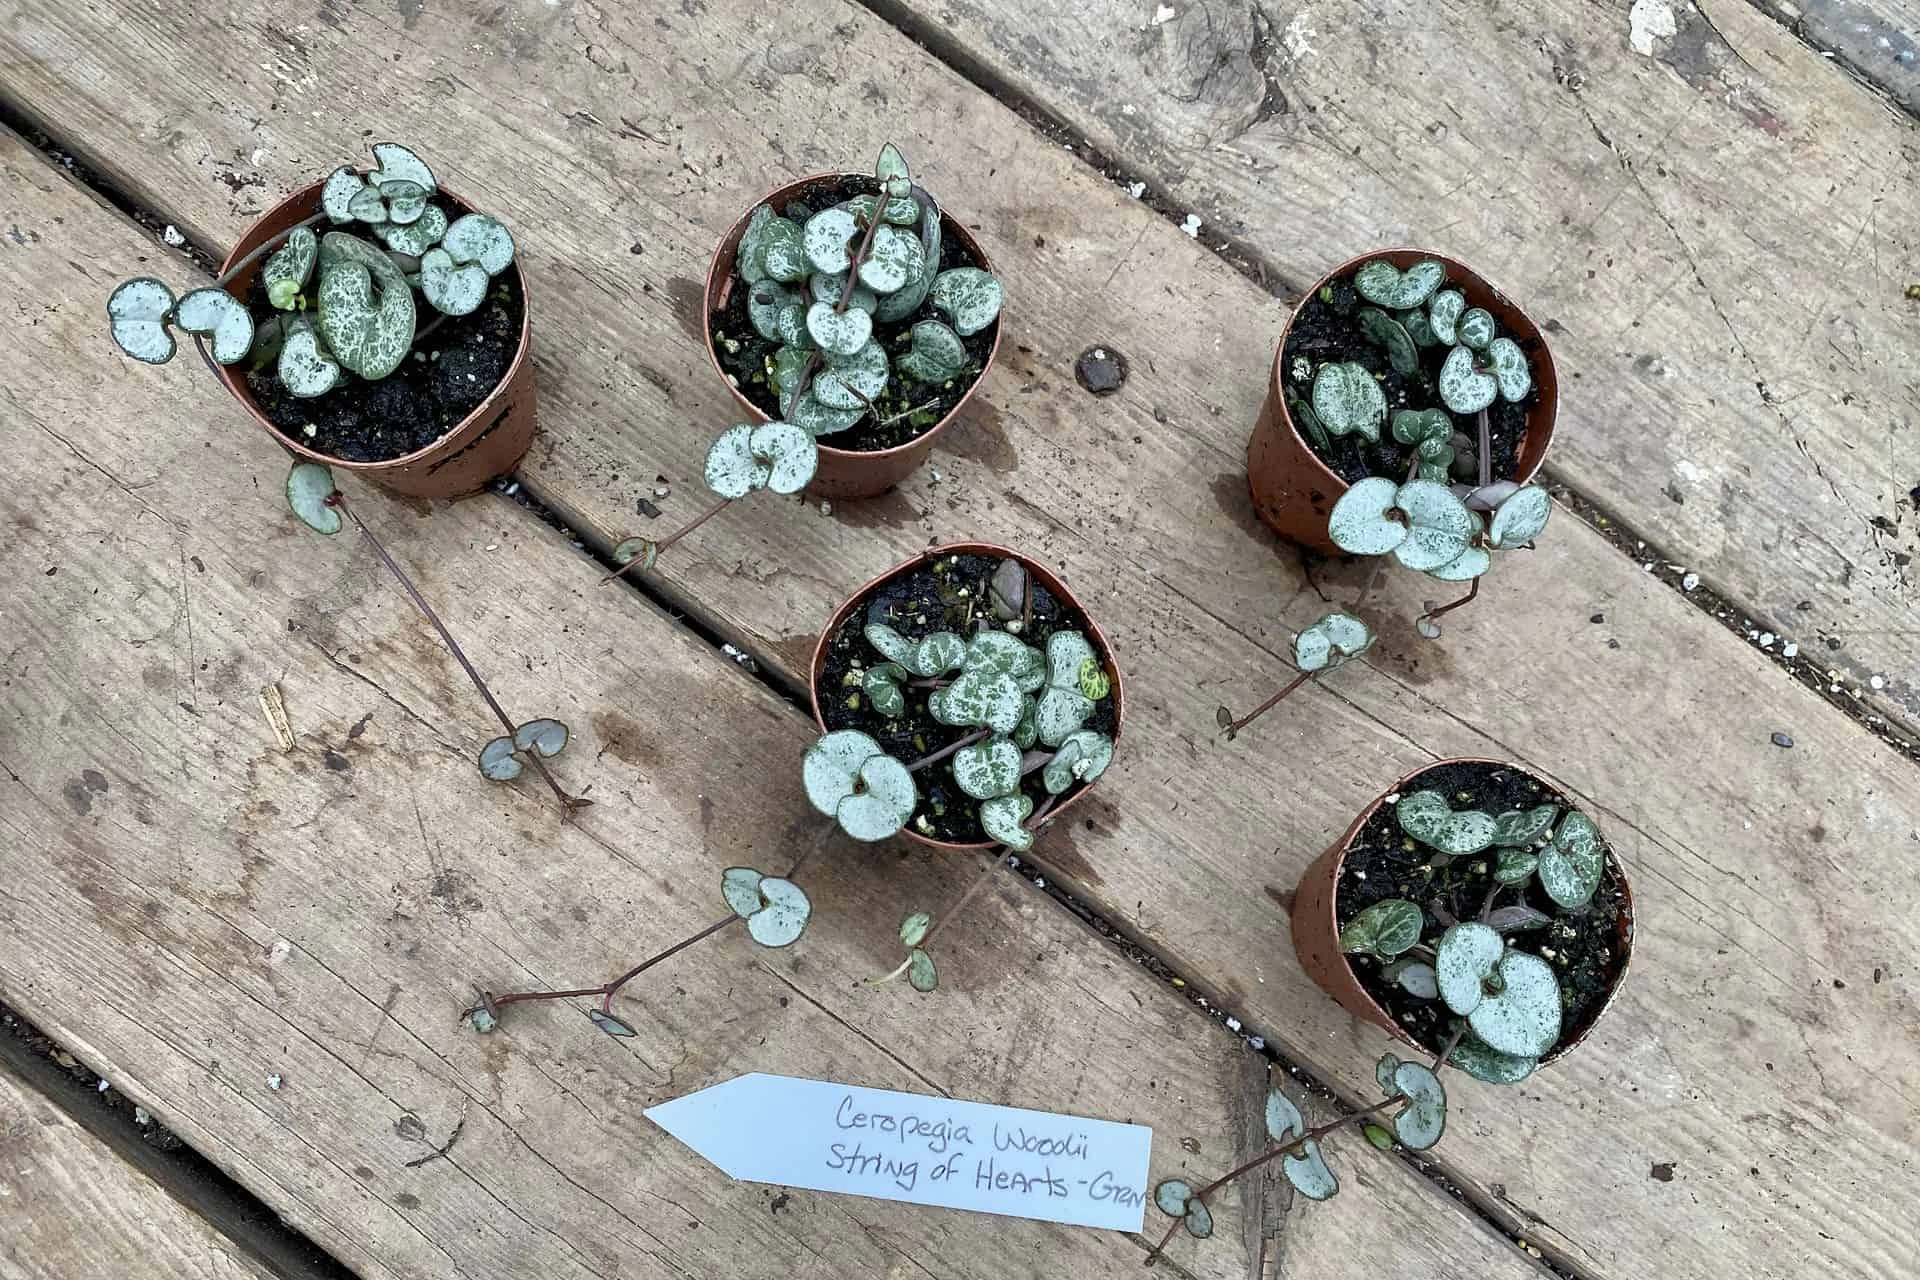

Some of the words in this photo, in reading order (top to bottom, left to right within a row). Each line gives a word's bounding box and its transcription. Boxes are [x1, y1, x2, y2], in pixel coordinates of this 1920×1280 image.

[836, 1094, 973, 1153] Ceropegia
[993, 1121, 1087, 1160] Woodii
[930, 1152, 963, 1181] of
